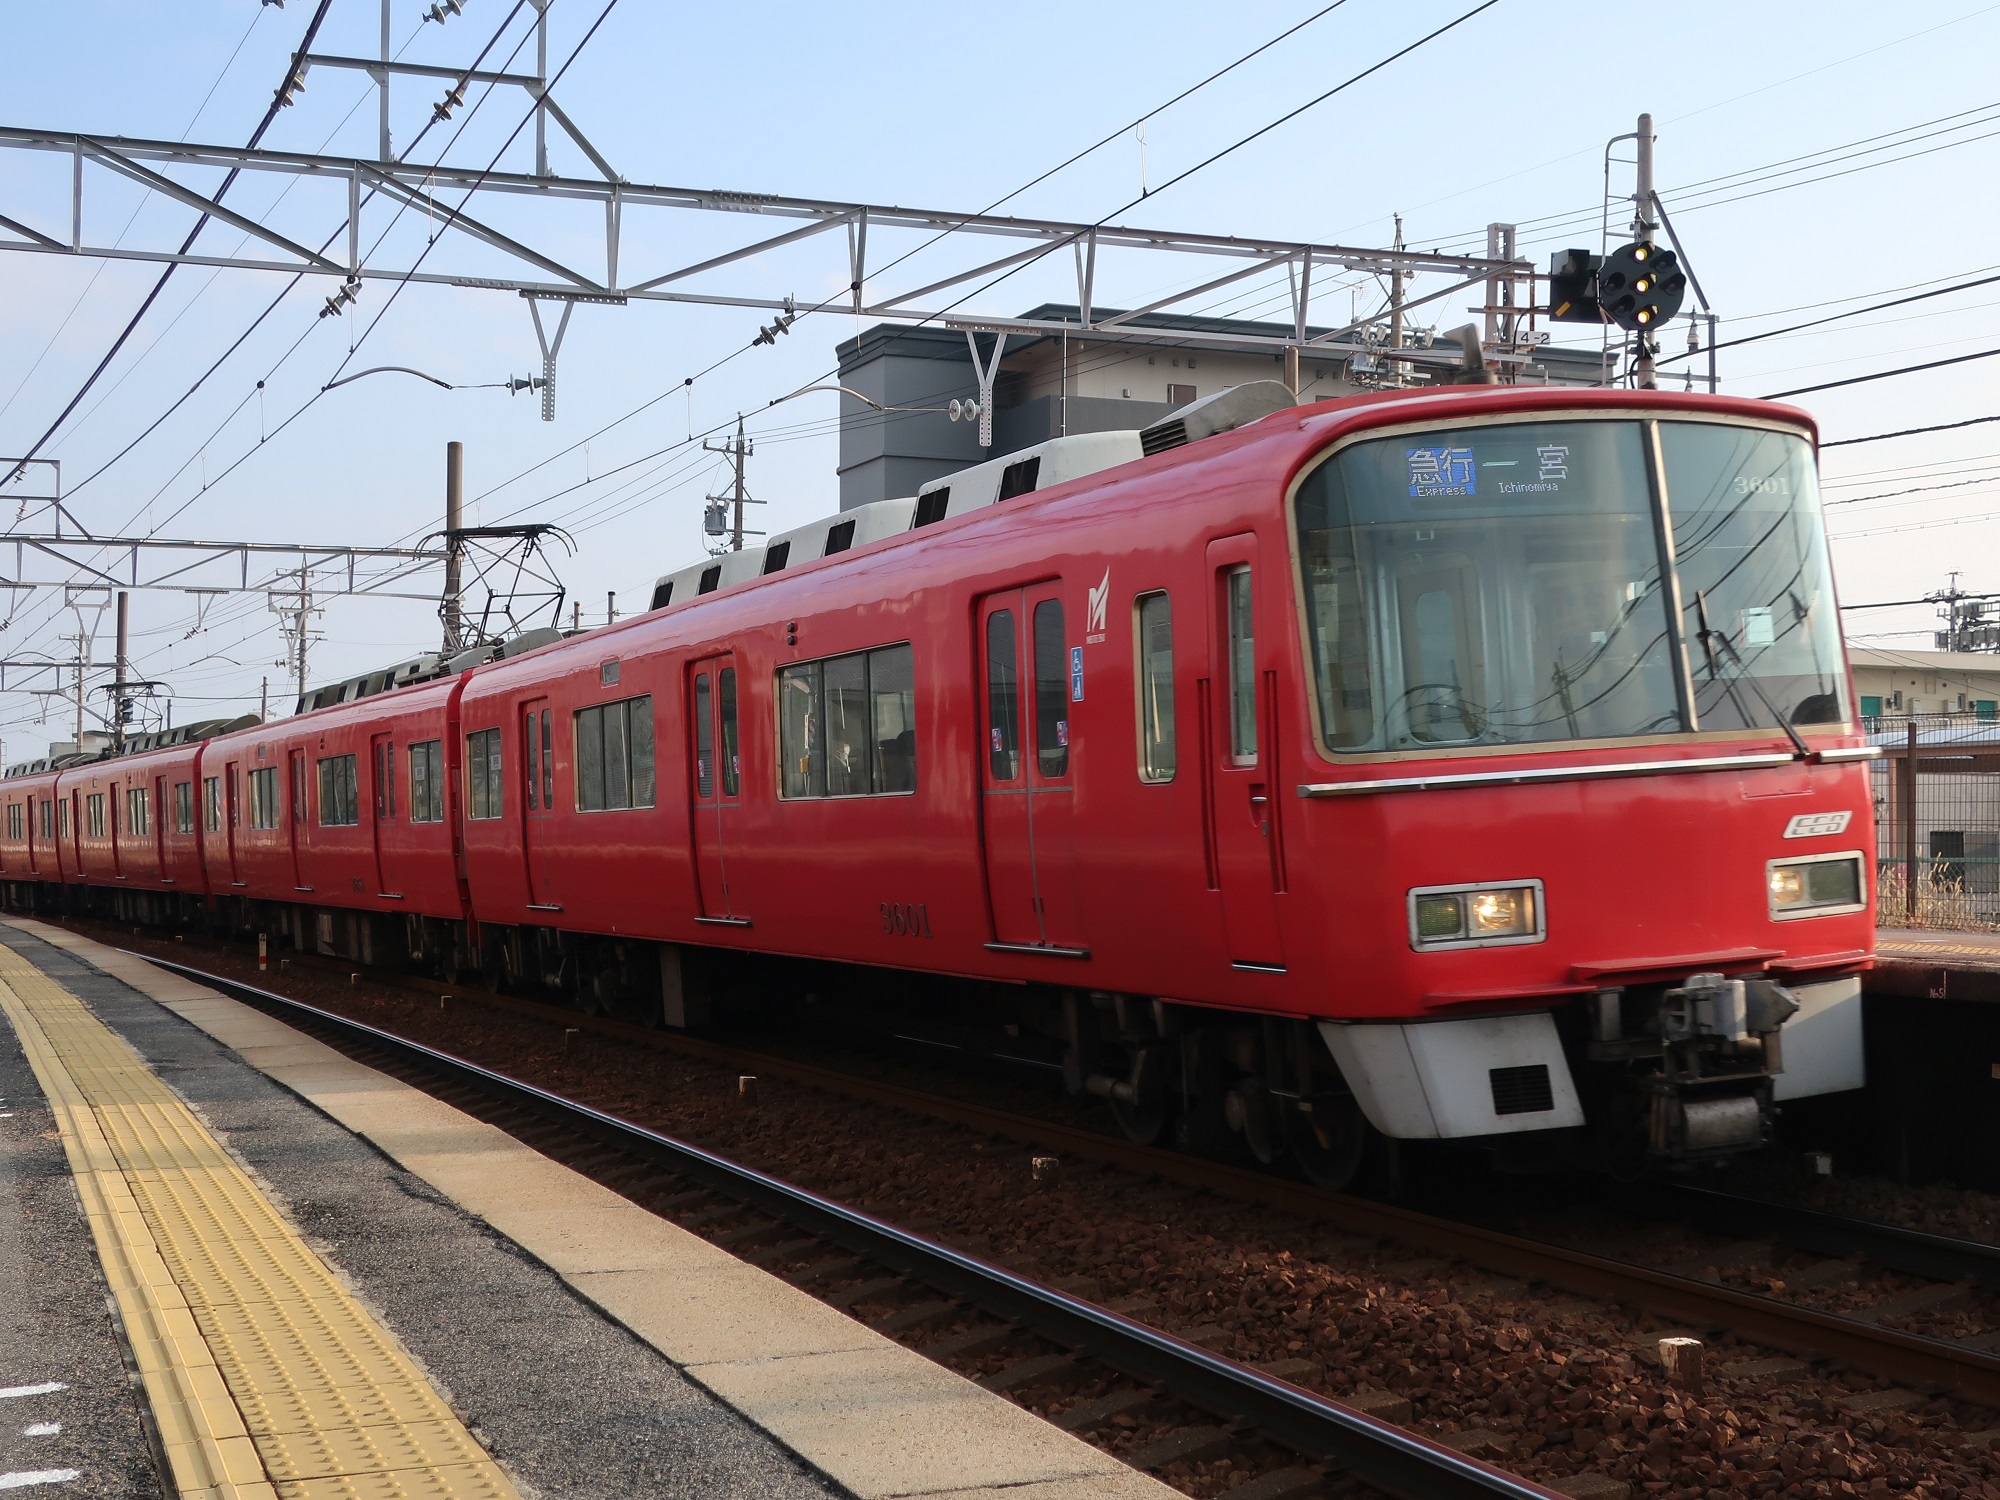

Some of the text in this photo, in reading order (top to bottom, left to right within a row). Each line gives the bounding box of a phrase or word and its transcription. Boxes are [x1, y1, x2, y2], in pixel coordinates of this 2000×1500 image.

[1520, 332, 1550, 344] 4-2
[1408, 447, 1473, 485] 急行
[1482, 444, 1569, 481] 一宮
[1417, 485, 1467, 497] Express
[1499, 481, 1559, 494] Ichinomiya
[1733, 476, 1790, 495] 3601
[880, 902, 933, 939] 3601
